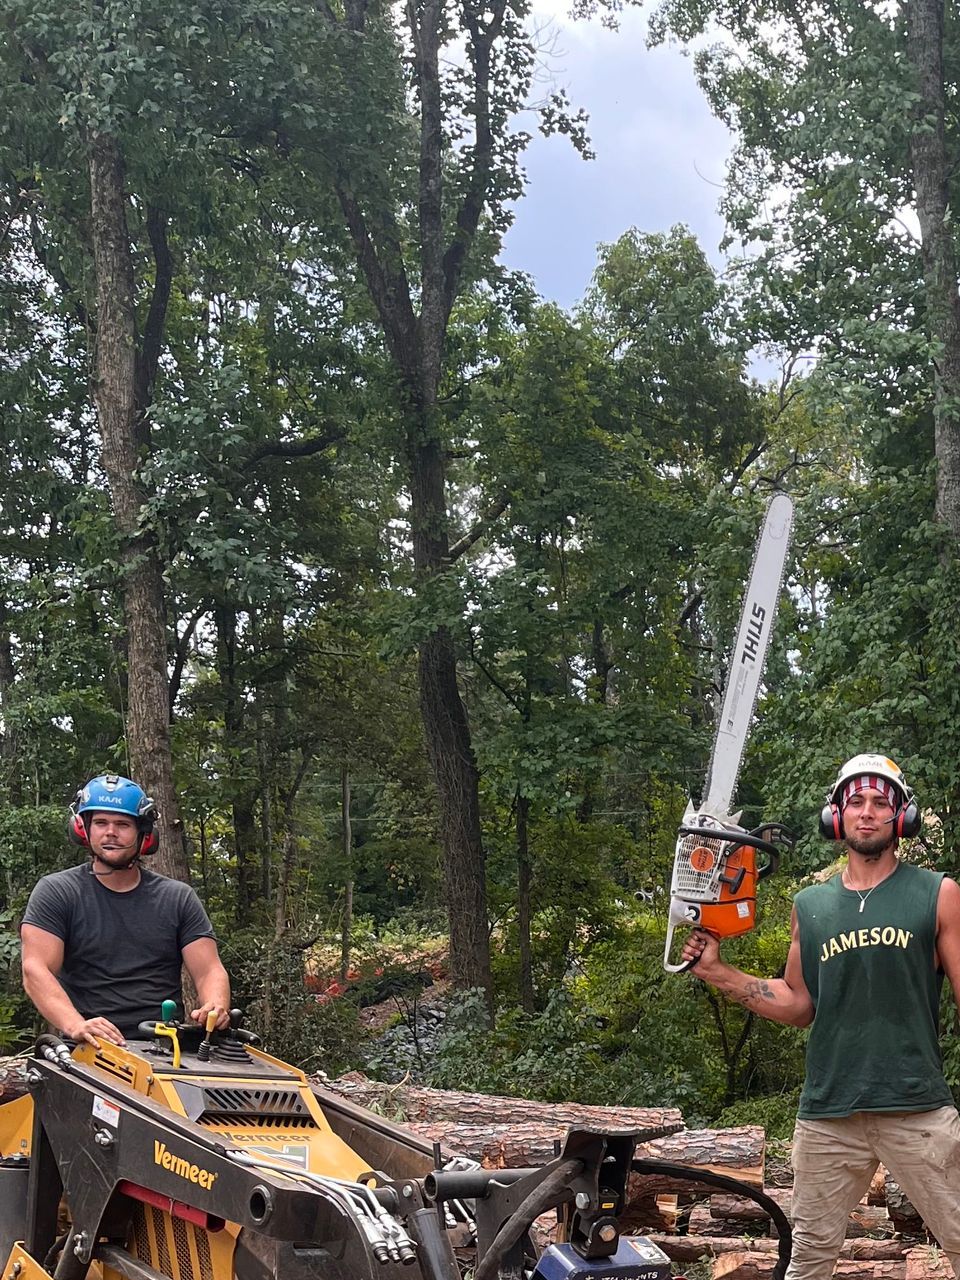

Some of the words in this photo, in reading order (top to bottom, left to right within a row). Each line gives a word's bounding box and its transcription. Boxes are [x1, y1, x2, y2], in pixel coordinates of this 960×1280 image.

[741, 602, 766, 665] STIHL
[98, 795, 122, 805] KASK
[820, 926, 911, 962] JAMESON
[154, 1139, 216, 1191] Vermeer
